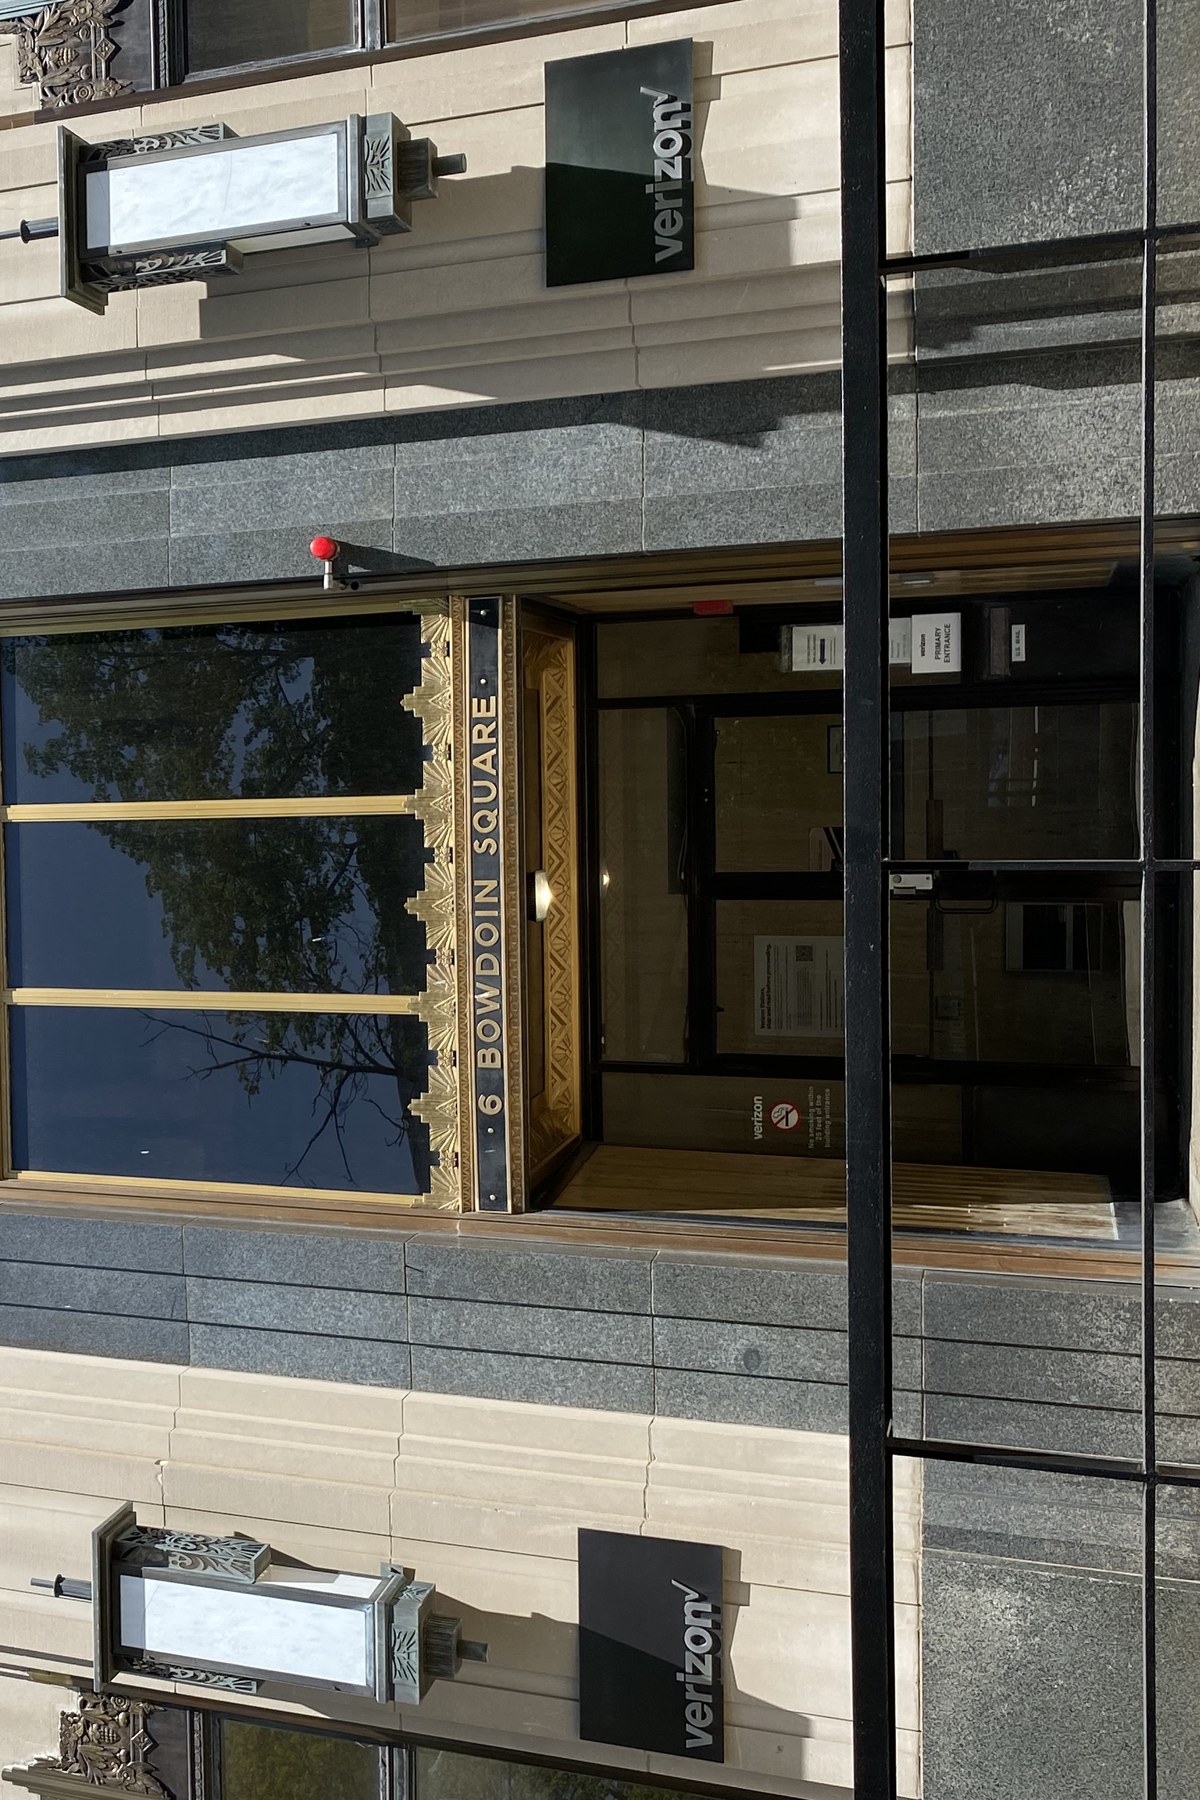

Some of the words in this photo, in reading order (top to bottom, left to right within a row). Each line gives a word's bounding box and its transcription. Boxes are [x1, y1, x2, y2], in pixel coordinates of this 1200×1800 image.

[644, 100, 684, 263] verizon
[934, 627, 942, 660] PRIMARY
[943, 623, 951, 663] ENTRANCE
[471, 694, 499, 855] SQUARE
[473, 879, 502, 1069] BOWDOIN
[478, 1094, 503, 1116] 6
[751, 1096, 763, 1140] verizon
[808, 1108, 816, 1137] smoking
[808, 1139, 815, 1149] No
[824, 1121, 832, 1148] building
[676, 1600, 714, 1749] verizon
